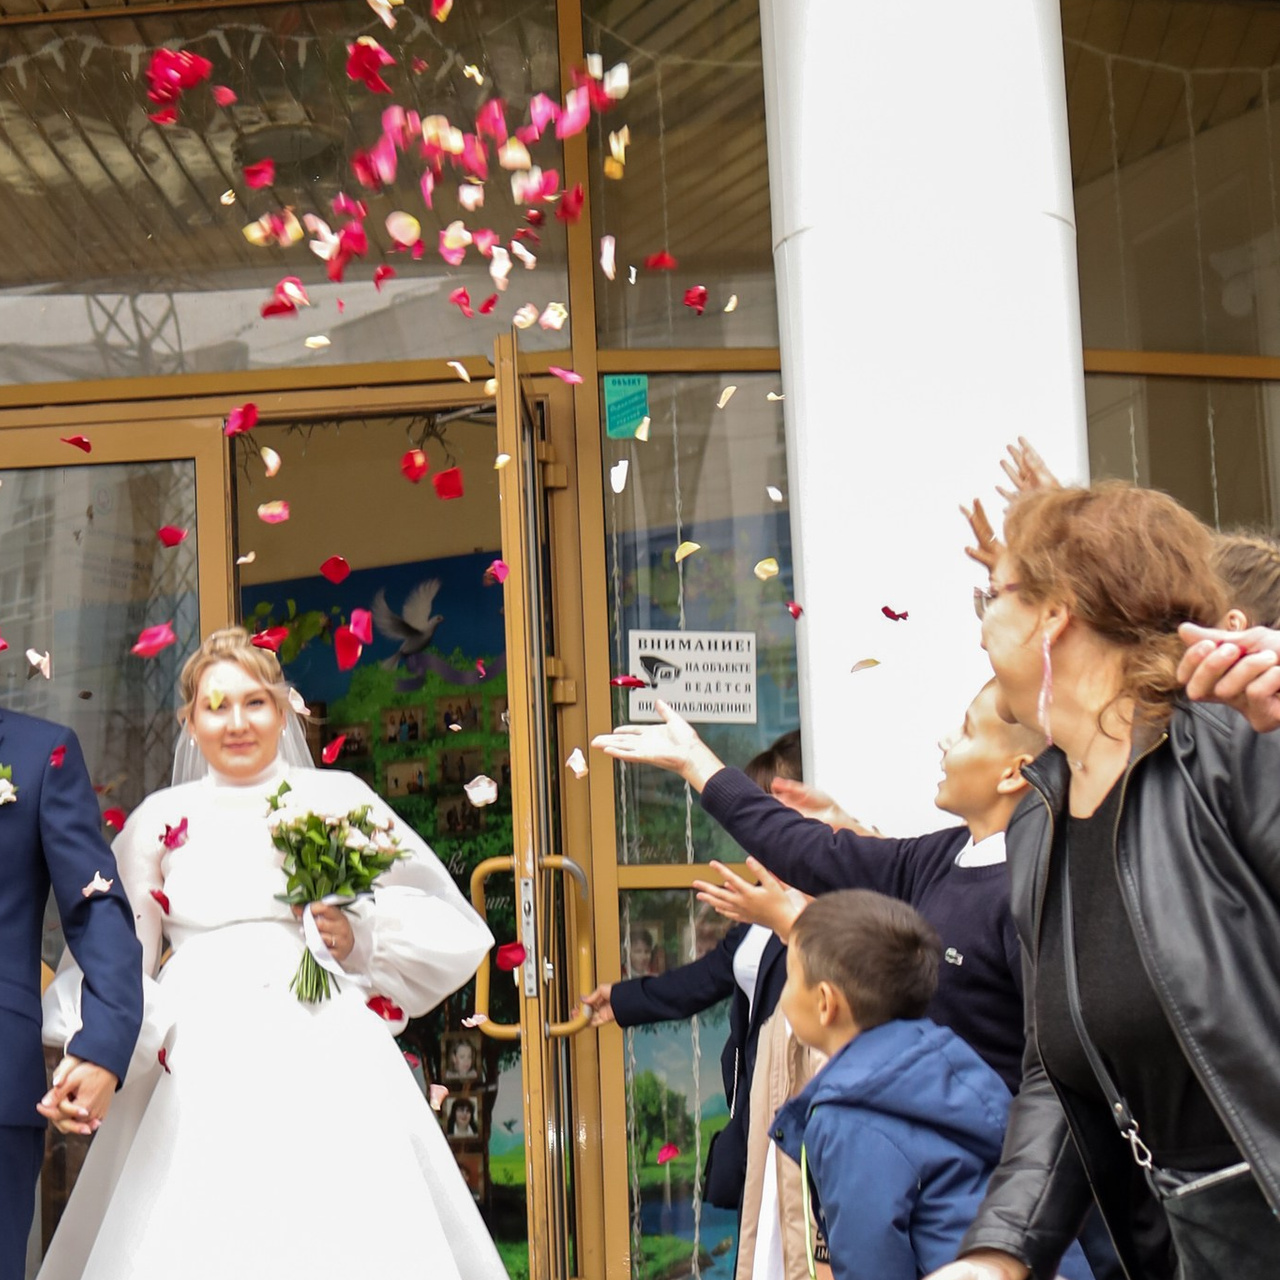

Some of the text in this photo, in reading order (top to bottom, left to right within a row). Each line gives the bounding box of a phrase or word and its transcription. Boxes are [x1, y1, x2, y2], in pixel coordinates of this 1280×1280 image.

[638, 637, 751, 652] ВНИМАНИЕ!
[685, 662, 751, 673] НА ОБЪЕКТЕ
[685, 681, 751, 694] ВЕДЁТСЯ
